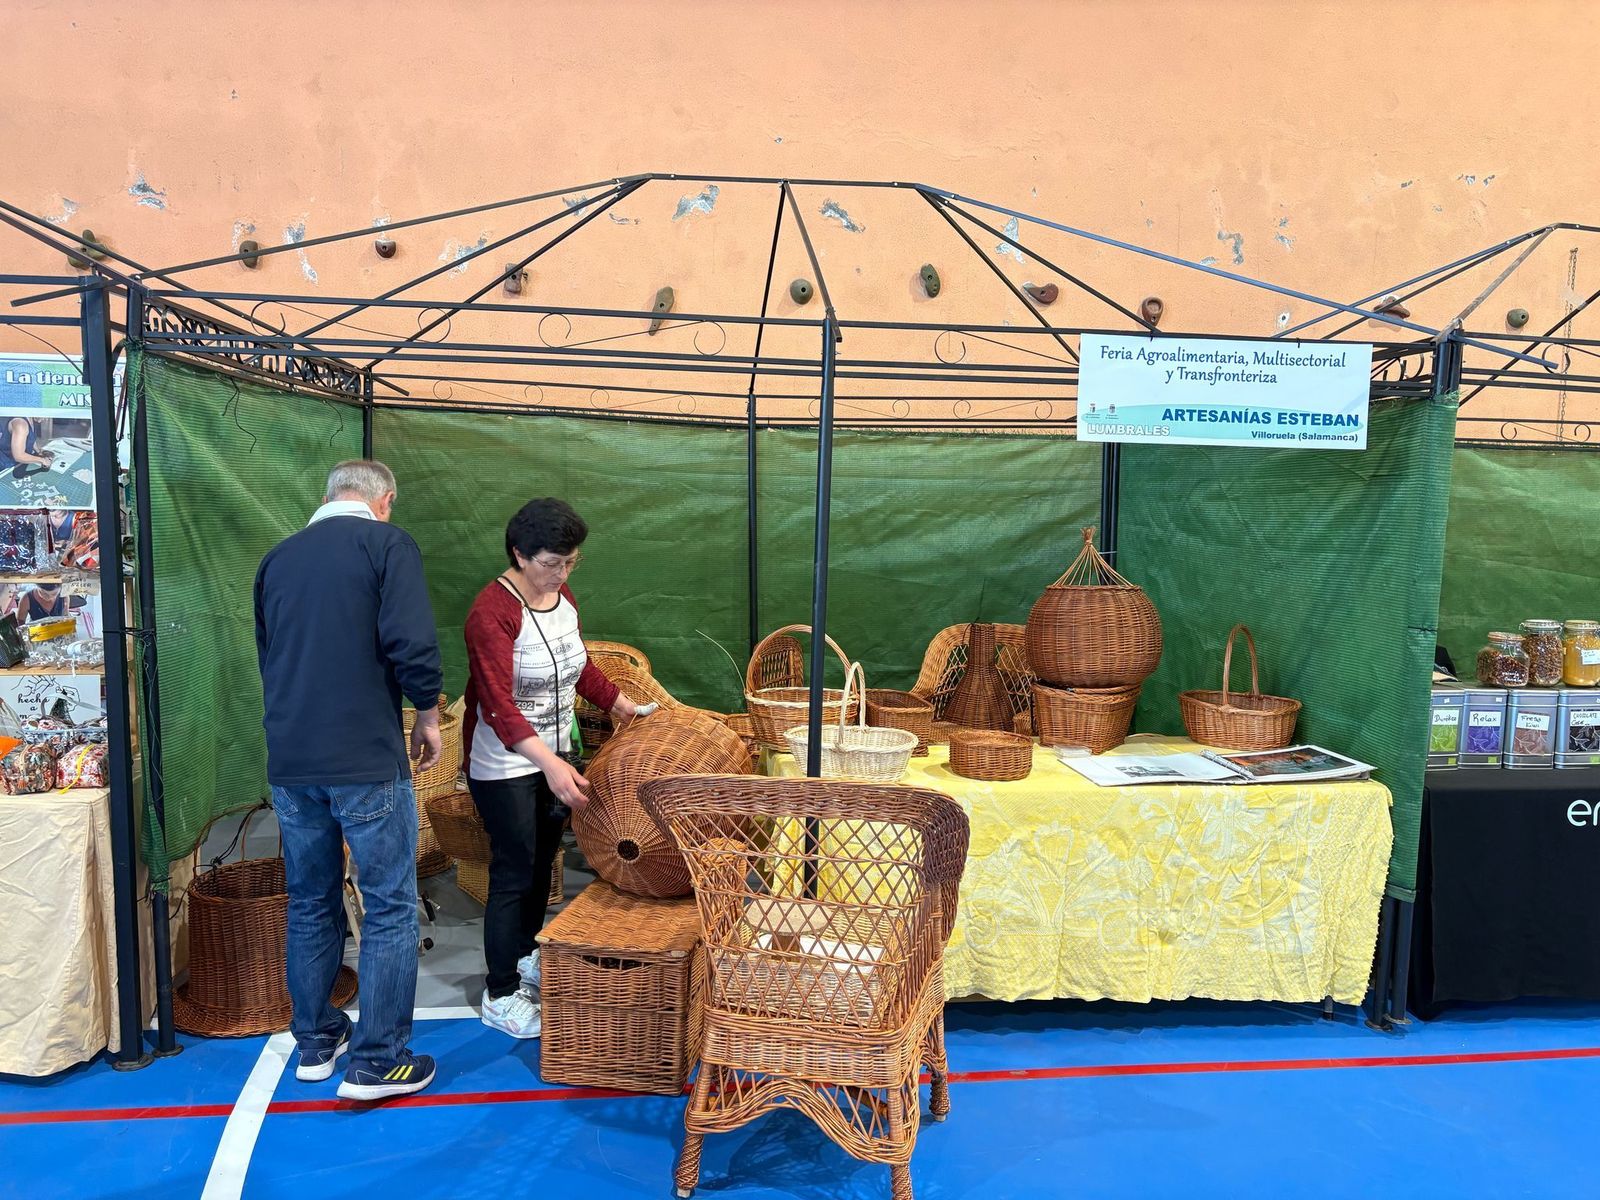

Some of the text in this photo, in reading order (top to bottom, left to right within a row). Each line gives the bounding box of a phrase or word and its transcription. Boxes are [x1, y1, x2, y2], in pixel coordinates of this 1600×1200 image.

[1100, 345, 1346, 367] Feria Agroalimentaria, Multisectorial
[5, 370, 83, 386] La tien
[1165, 365, 1278, 386] y Transfronteriza
[1161, 407, 1359, 427] ARTESANÍAS ESTEBAN
[1087, 423, 1170, 436] LUMBRALES
[1251, 431, 1358, 442] Villoruela (Salamanca)
[1472, 713, 1497, 725] Relax
